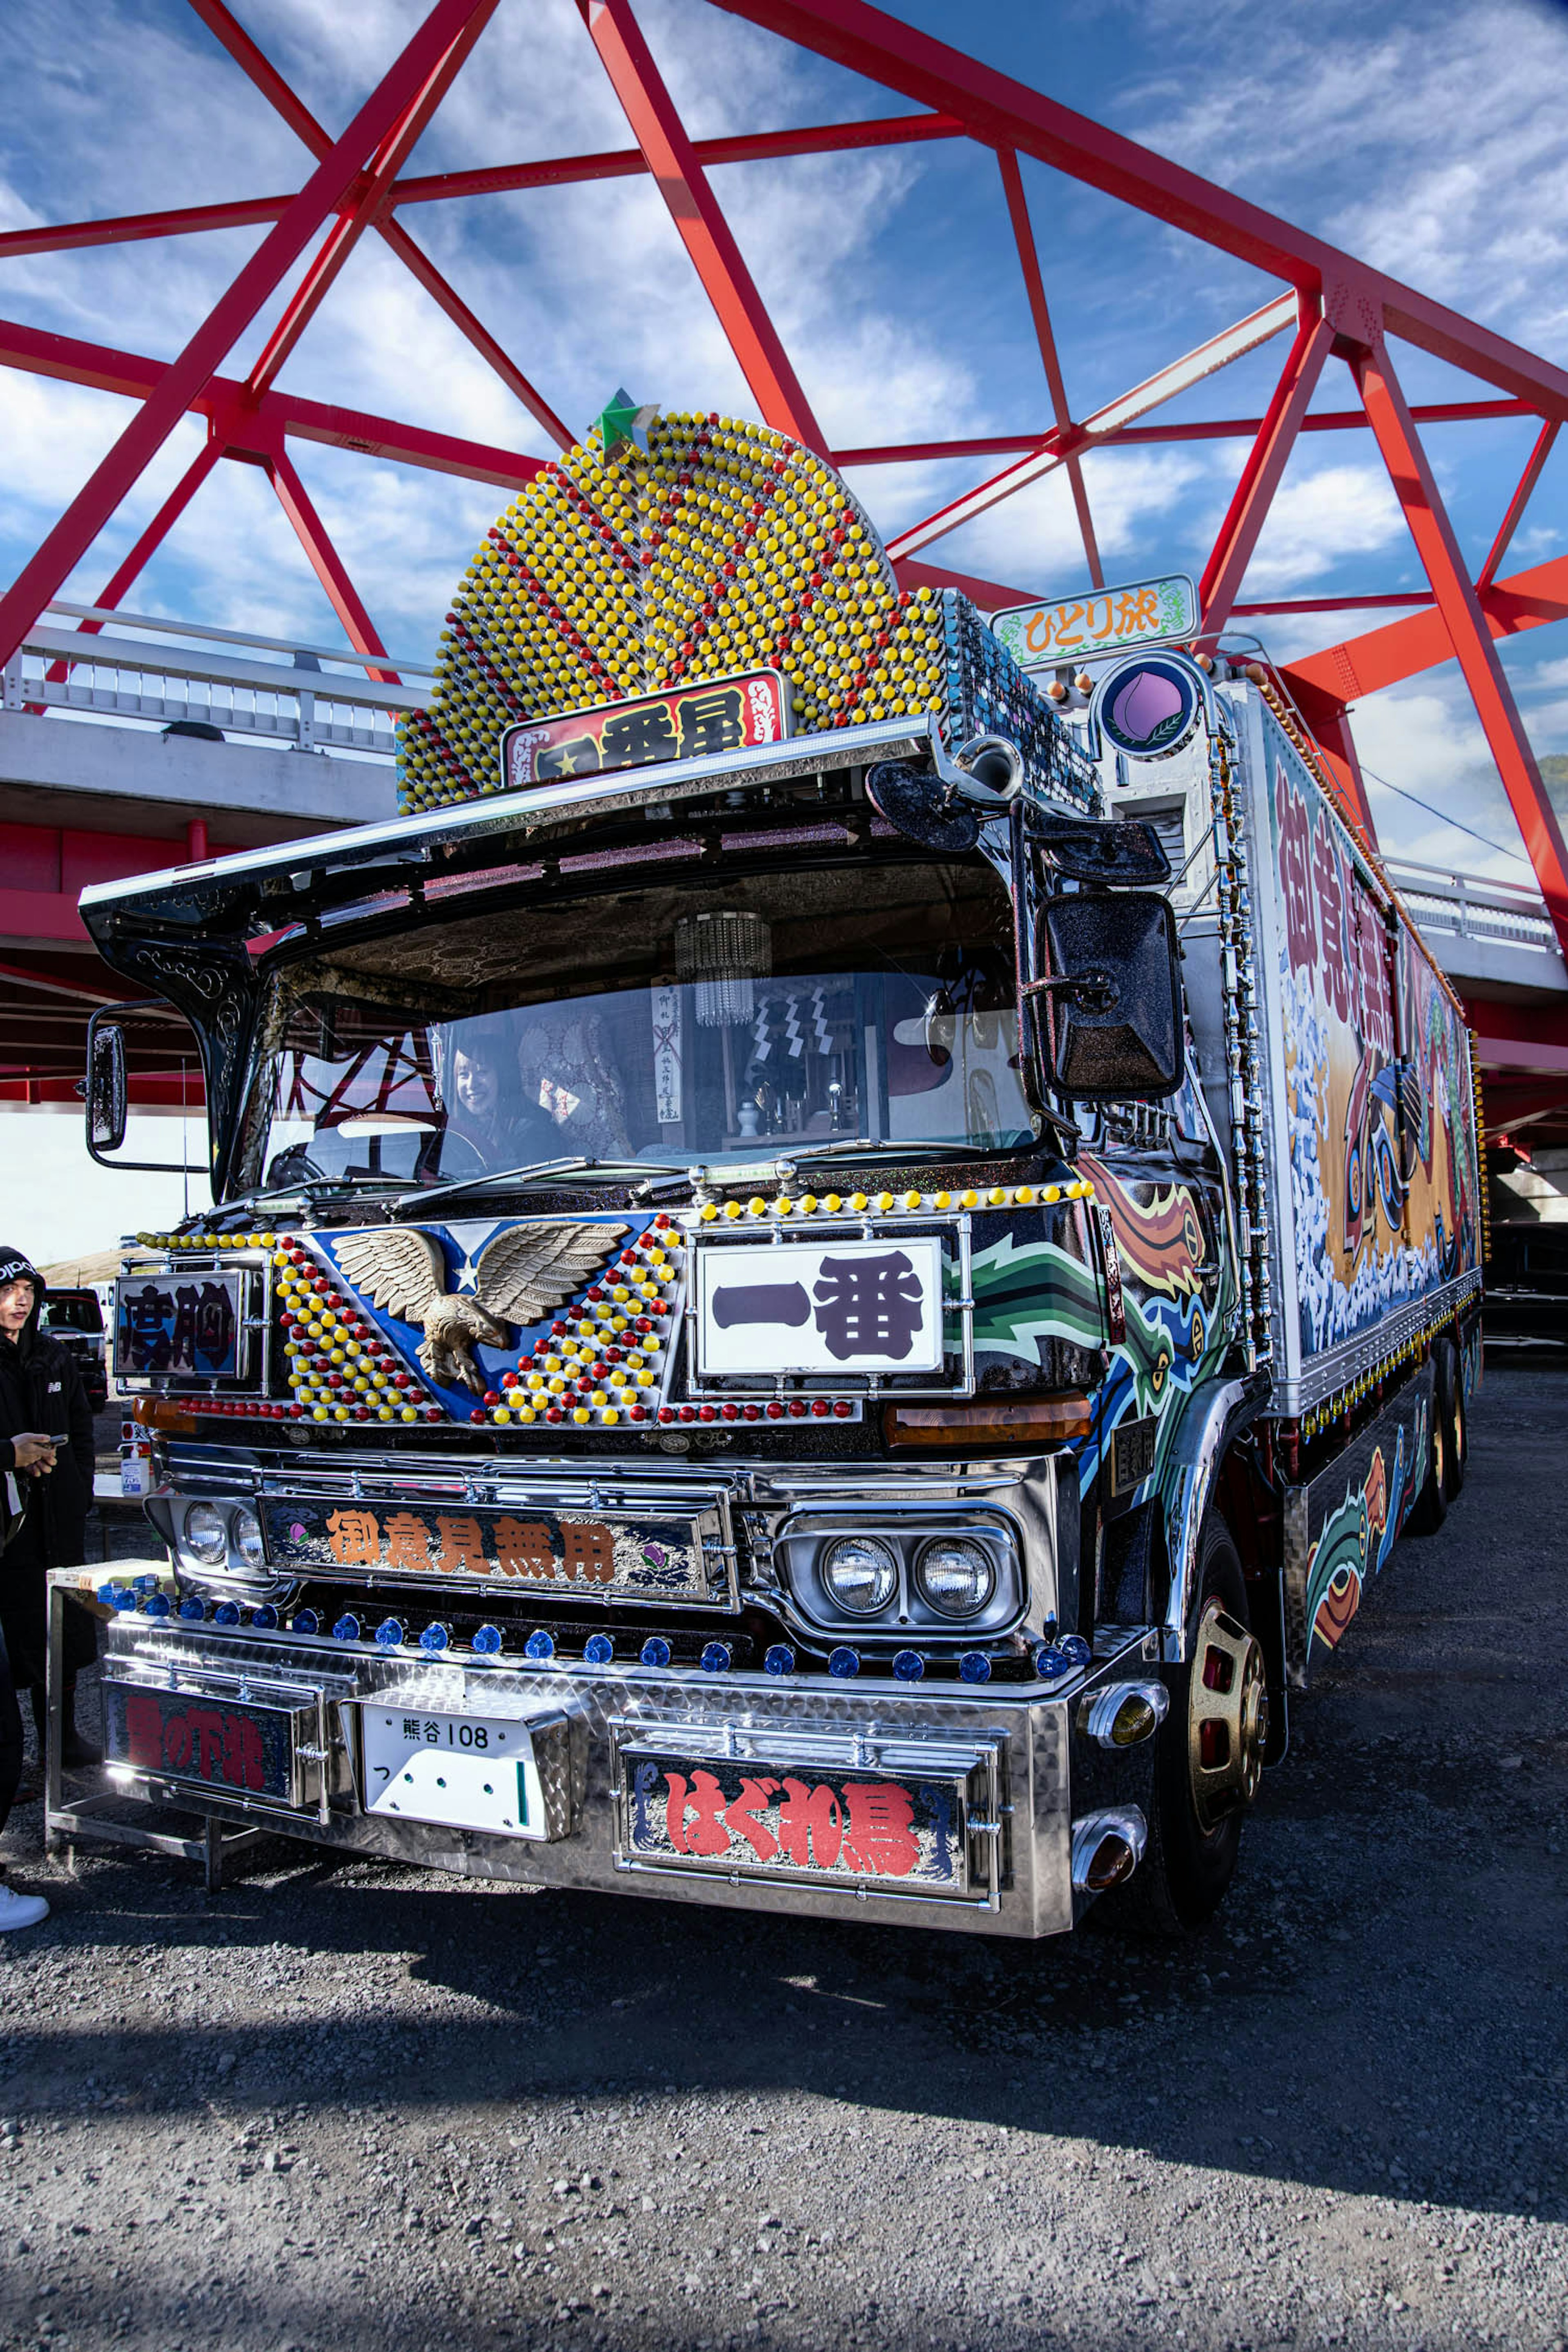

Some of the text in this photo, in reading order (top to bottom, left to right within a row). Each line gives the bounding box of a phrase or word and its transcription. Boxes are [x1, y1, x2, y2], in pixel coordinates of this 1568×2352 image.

[1025, 588, 1160, 653] ひとり旅
[712, 1250, 924, 1361] 一番
[327, 1508, 616, 1583] 御意見無用
[403, 1718, 488, 1749] 熊谷 108
[664, 1770, 920, 1876] はぐれ鳥
